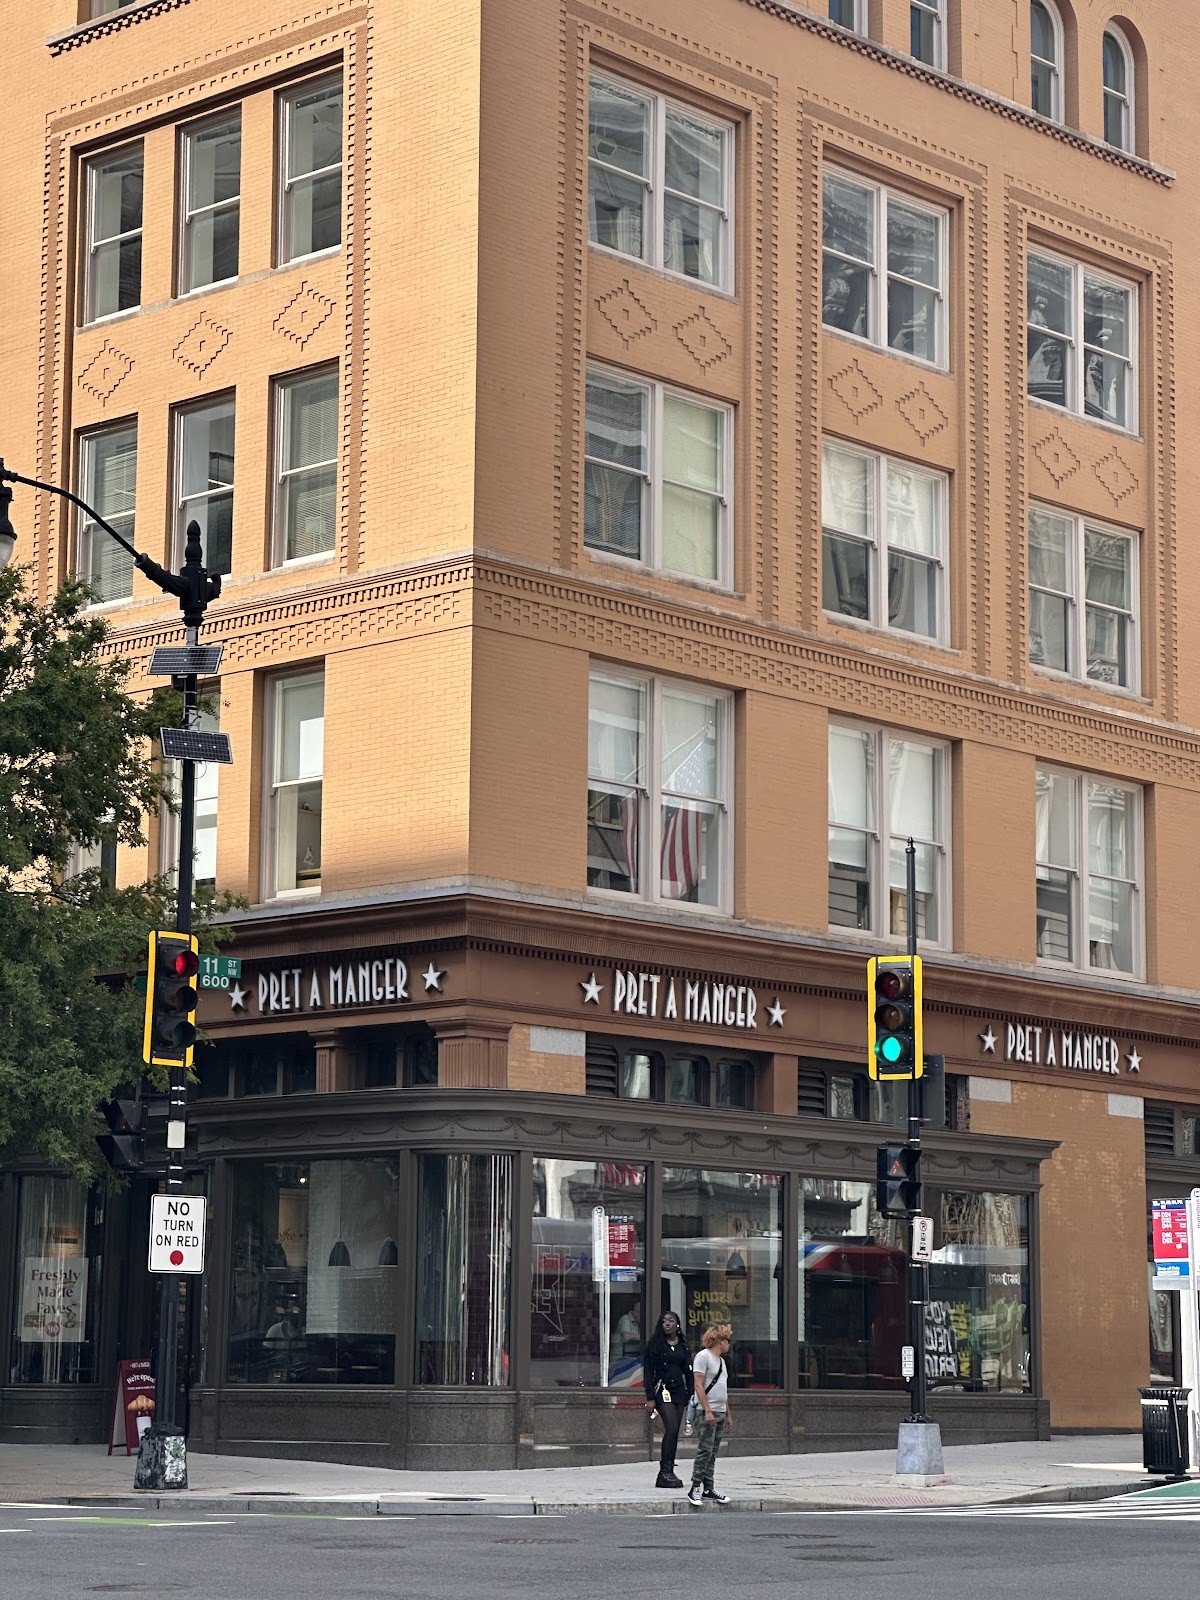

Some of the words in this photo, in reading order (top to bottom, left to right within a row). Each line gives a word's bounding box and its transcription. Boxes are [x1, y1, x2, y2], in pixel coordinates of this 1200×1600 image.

[203, 957, 218, 974] 11
[228, 960, 237, 968] ST
[202, 974, 229, 988] 600
[258, 968, 302, 1012] PRET
[309, 968, 321, 1007] A
[330, 958, 409, 1005] MANGER
[613, 969, 661, 1017] PRET
[664, 976, 678, 1019] A
[685, 978, 758, 1029] MANGER
[1005, 1022, 1043, 1064] PRET
[1046, 1028, 1057, 1066] A
[1061, 1030, 1120, 1075] MANGER
[168, 1201, 190, 1216] NO
[163, 1219, 194, 1231] TURN
[156, 1234, 172, 1246] ON
[177, 1235, 199, 1247] RED
[31, 1269, 81, 1283] Freshly
[37, 1286, 74, 1298] Made
